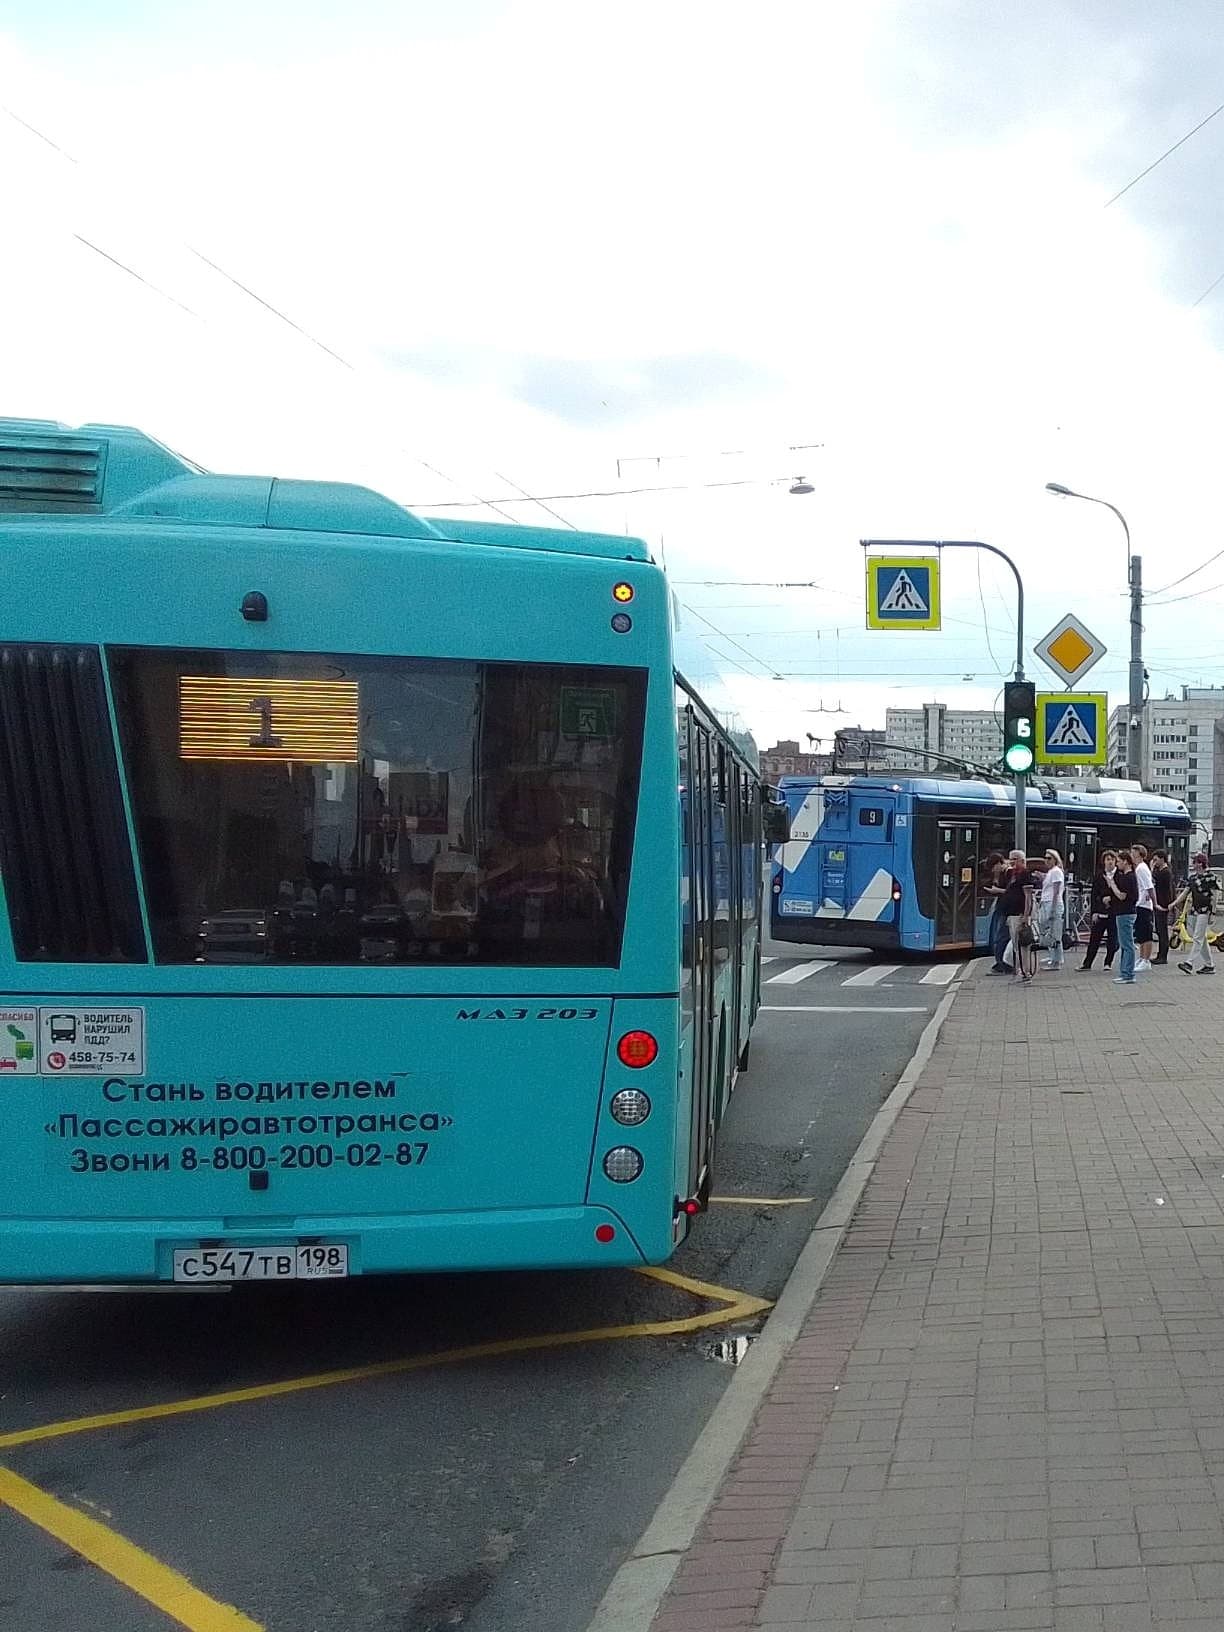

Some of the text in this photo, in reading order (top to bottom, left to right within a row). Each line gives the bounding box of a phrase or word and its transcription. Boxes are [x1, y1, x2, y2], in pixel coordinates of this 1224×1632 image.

[249, 697, 282, 747] 1
[1017, 717, 1031, 738] 6
[869, 811, 876, 823] 9
[84, 1014, 133, 1024] ВОДИТЕЛЬ
[456, 1008, 598, 1020] МАЗ 203
[84, 1025, 131, 1034] НАРУШИЛ
[85, 1035, 111, 1045] ПДД?
[69, 1052, 136, 1062] 458-75-74
[102, 1078, 396, 1103] Стань водителем
[44, 1113, 454, 1141] «Пассажиравтотранса»
[71, 1142, 429, 1172] Звони 8-800-200-02-87
[299, 1248, 340, 1266] 198
